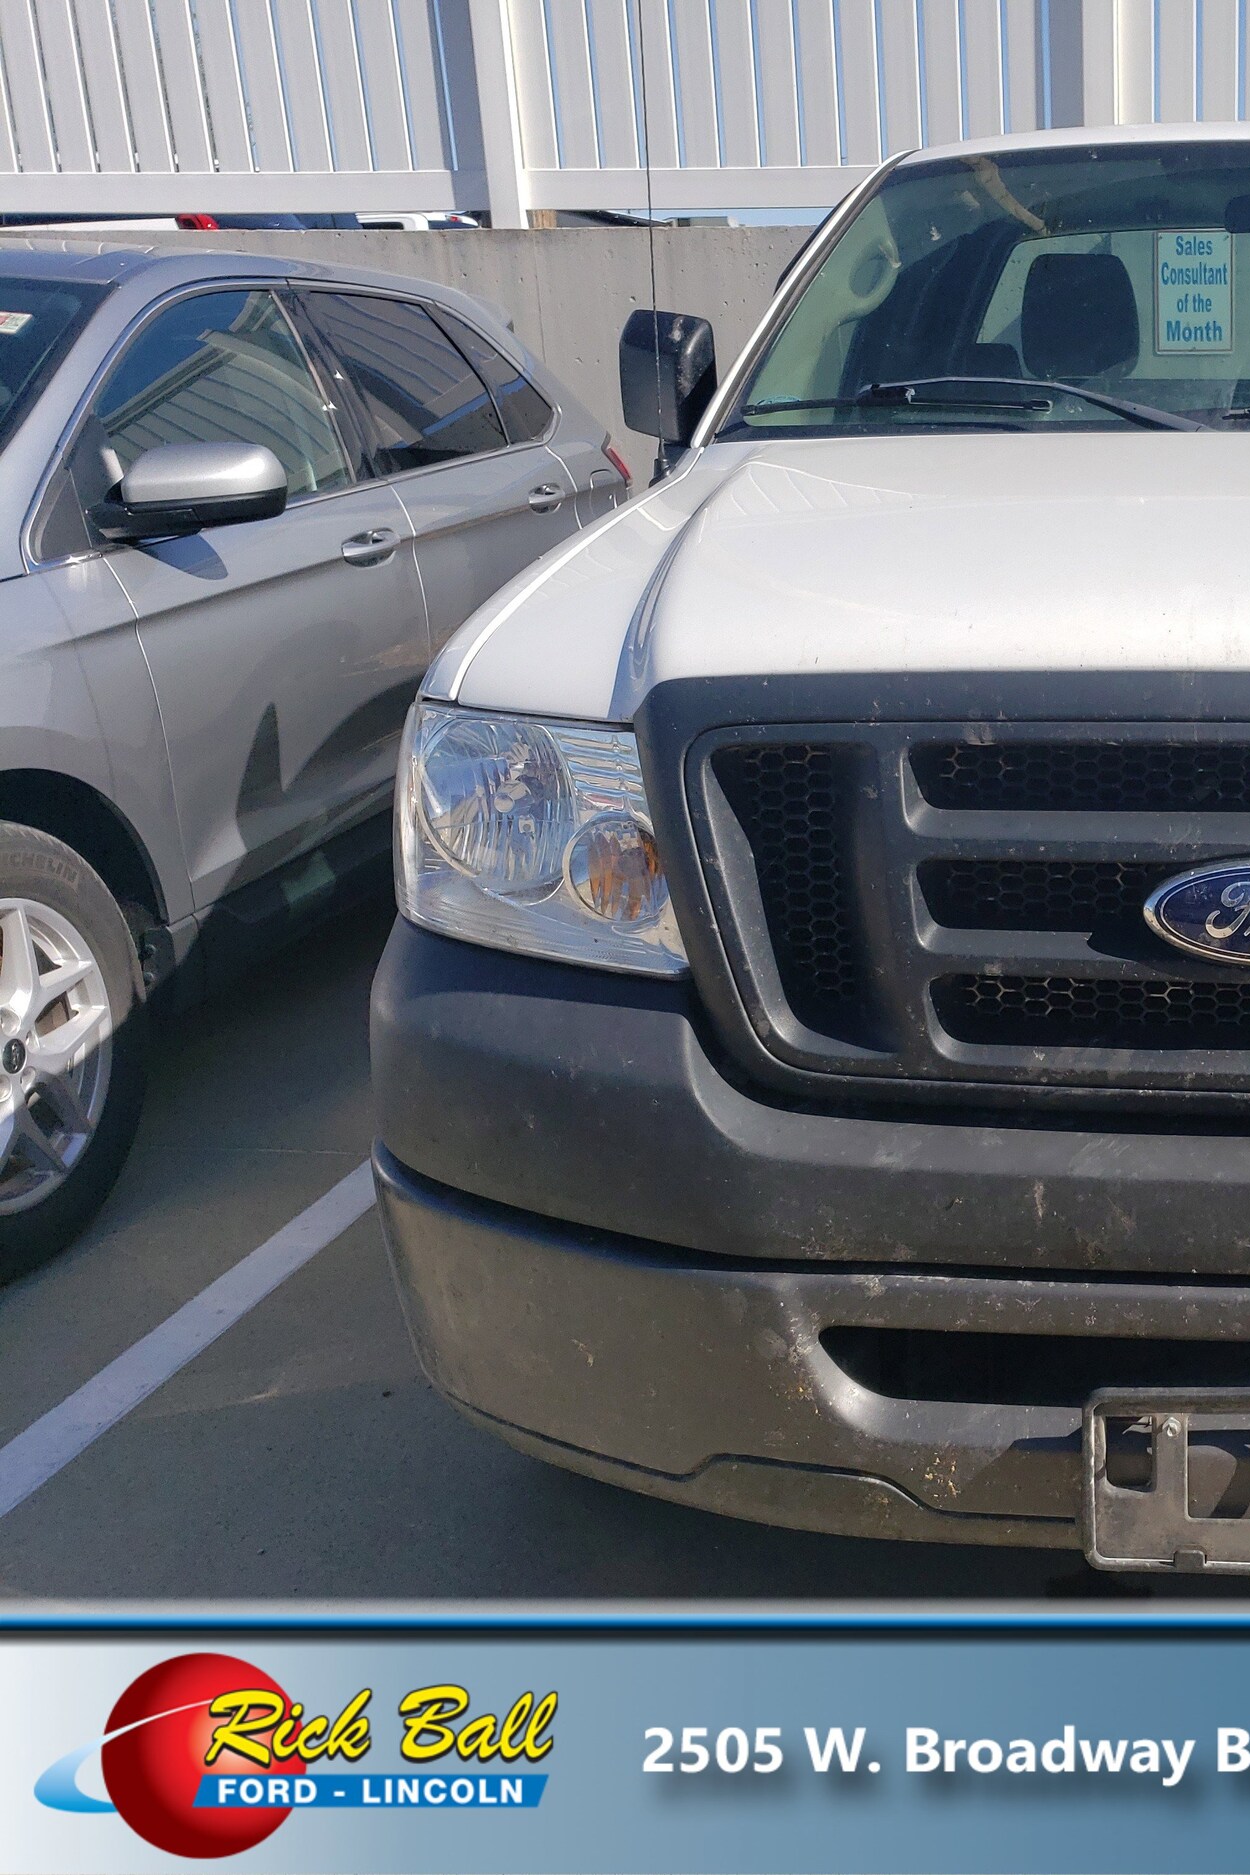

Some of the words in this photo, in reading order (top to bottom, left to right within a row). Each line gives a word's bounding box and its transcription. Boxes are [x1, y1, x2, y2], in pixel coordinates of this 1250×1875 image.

[1175, 235, 1213, 256] Sales
[1161, 261, 1228, 286] Consultant
[1176, 293, 1190, 313] of
[1192, 293, 1213, 313] the
[1166, 320, 1222, 342] Month
